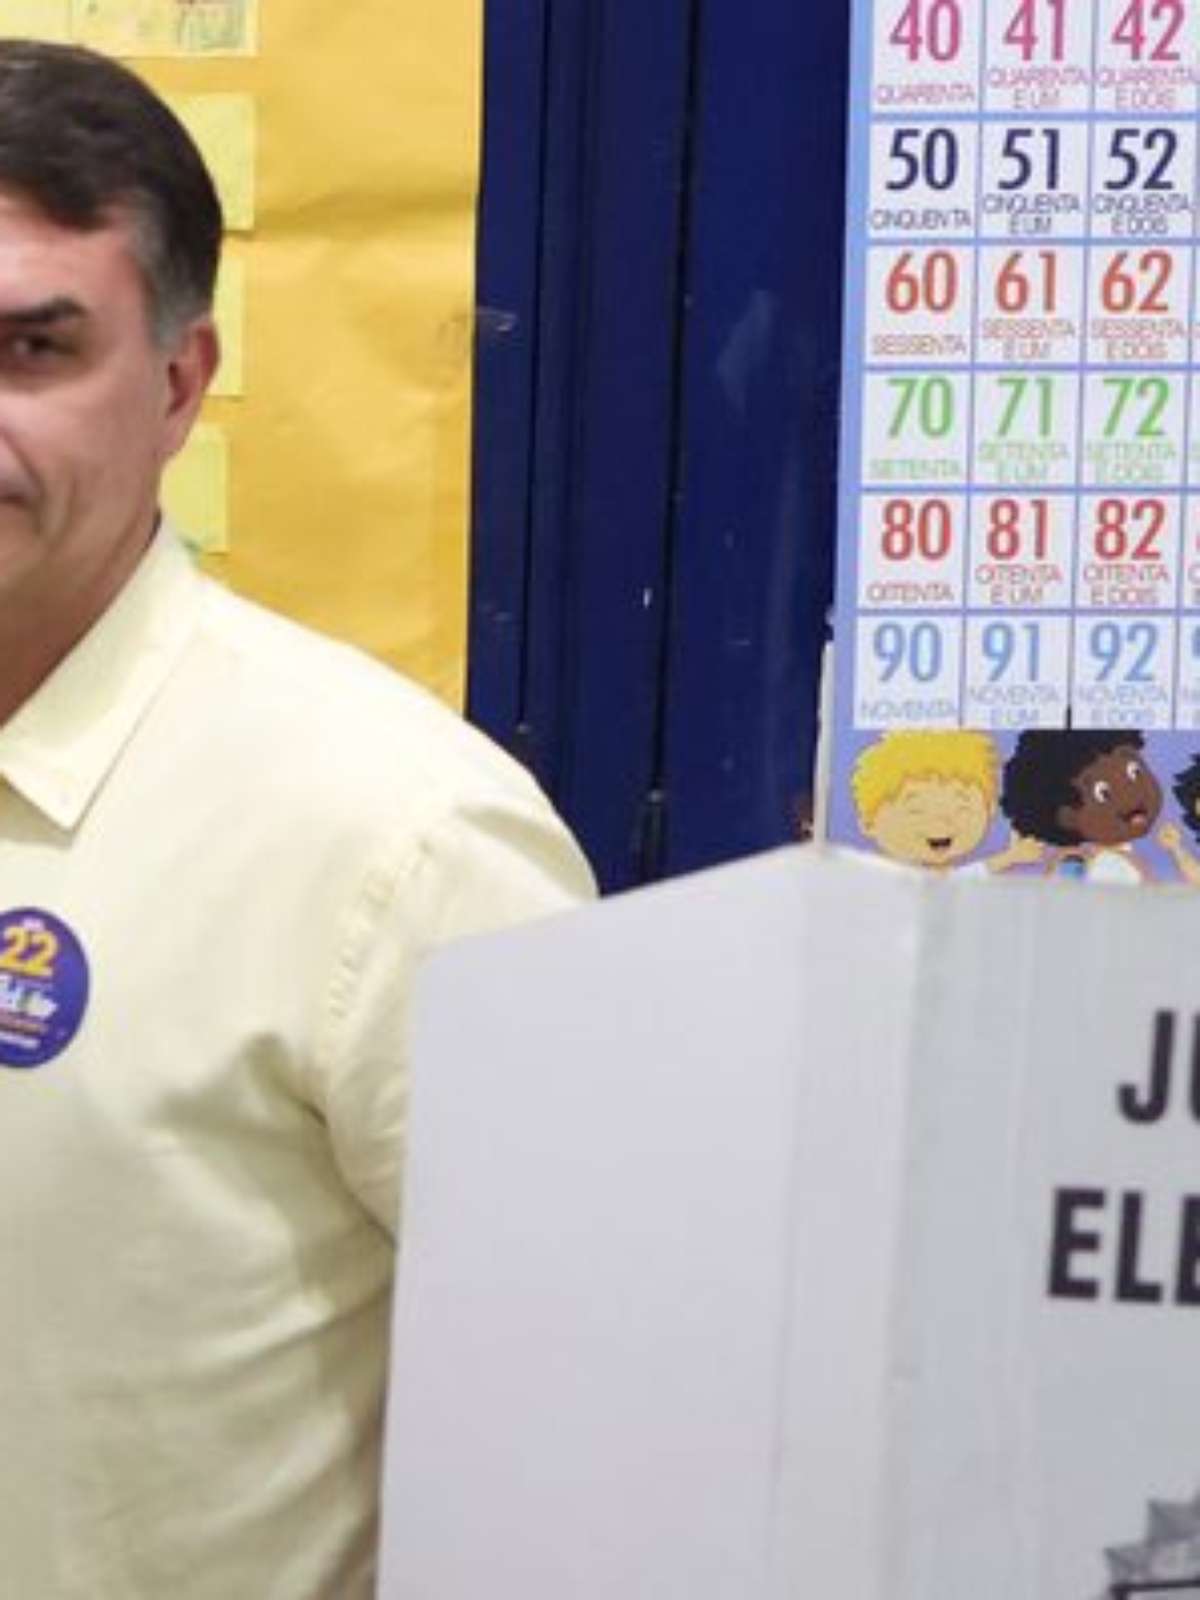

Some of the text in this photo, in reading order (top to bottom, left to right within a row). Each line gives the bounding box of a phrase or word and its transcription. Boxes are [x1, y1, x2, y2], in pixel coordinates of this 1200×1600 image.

[890, 0, 961, 61] 40
[1003, 0, 1064, 61] 41
[1111, 0, 1184, 61] 42
[886, 128, 958, 191] 50
[998, 128, 1060, 190] 51
[1104, 128, 1178, 190] 52
[869, 209, 971, 230] CINQUENTA
[886, 250, 957, 314] 60
[995, 250, 1056, 313] 61
[1101, 250, 1173, 313] 62
[886, 377, 956, 439] 70
[997, 377, 1053, 437] 71
[1103, 377, 1170, 437] 72
[882, 499, 951, 561] 80
[987, 499, 1048, 561] 81
[1094, 499, 1165, 561] 82
[867, 581, 954, 603] OITENTA
[873, 622, 942, 683] 90
[981, 622, 1040, 682] 91
[1090, 622, 1158, 682] 92
[0, 926, 58, 977] 22
[1116, 1008, 1200, 1124] J
